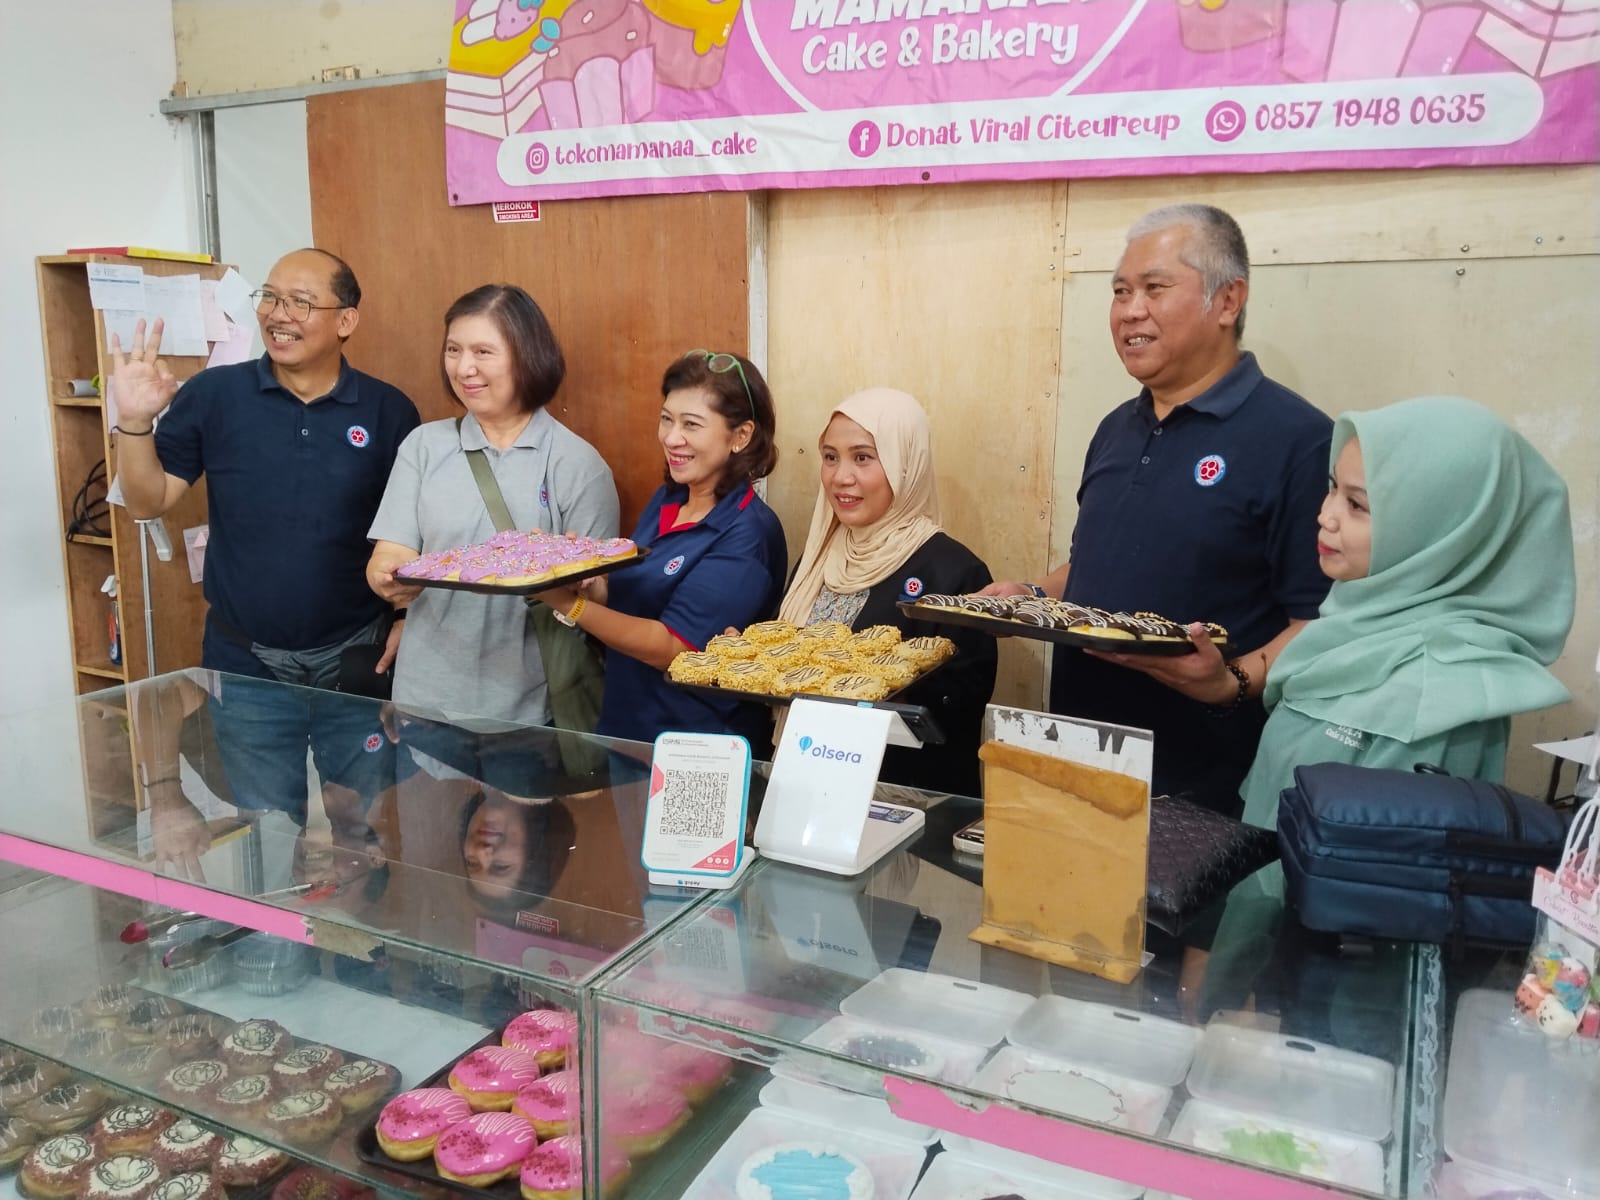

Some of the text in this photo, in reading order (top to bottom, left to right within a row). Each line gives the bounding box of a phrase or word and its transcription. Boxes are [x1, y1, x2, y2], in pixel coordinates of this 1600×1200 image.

[802, 19, 1079, 74] Cake & Bakery
[1255, 94, 1485, 131] 0857 1948 0635
[887, 113, 1180, 148] Donat Viral Citeureup
[555, 132, 758, 165] tokomamanaa_cake
[812, 744, 862, 763] olsera
